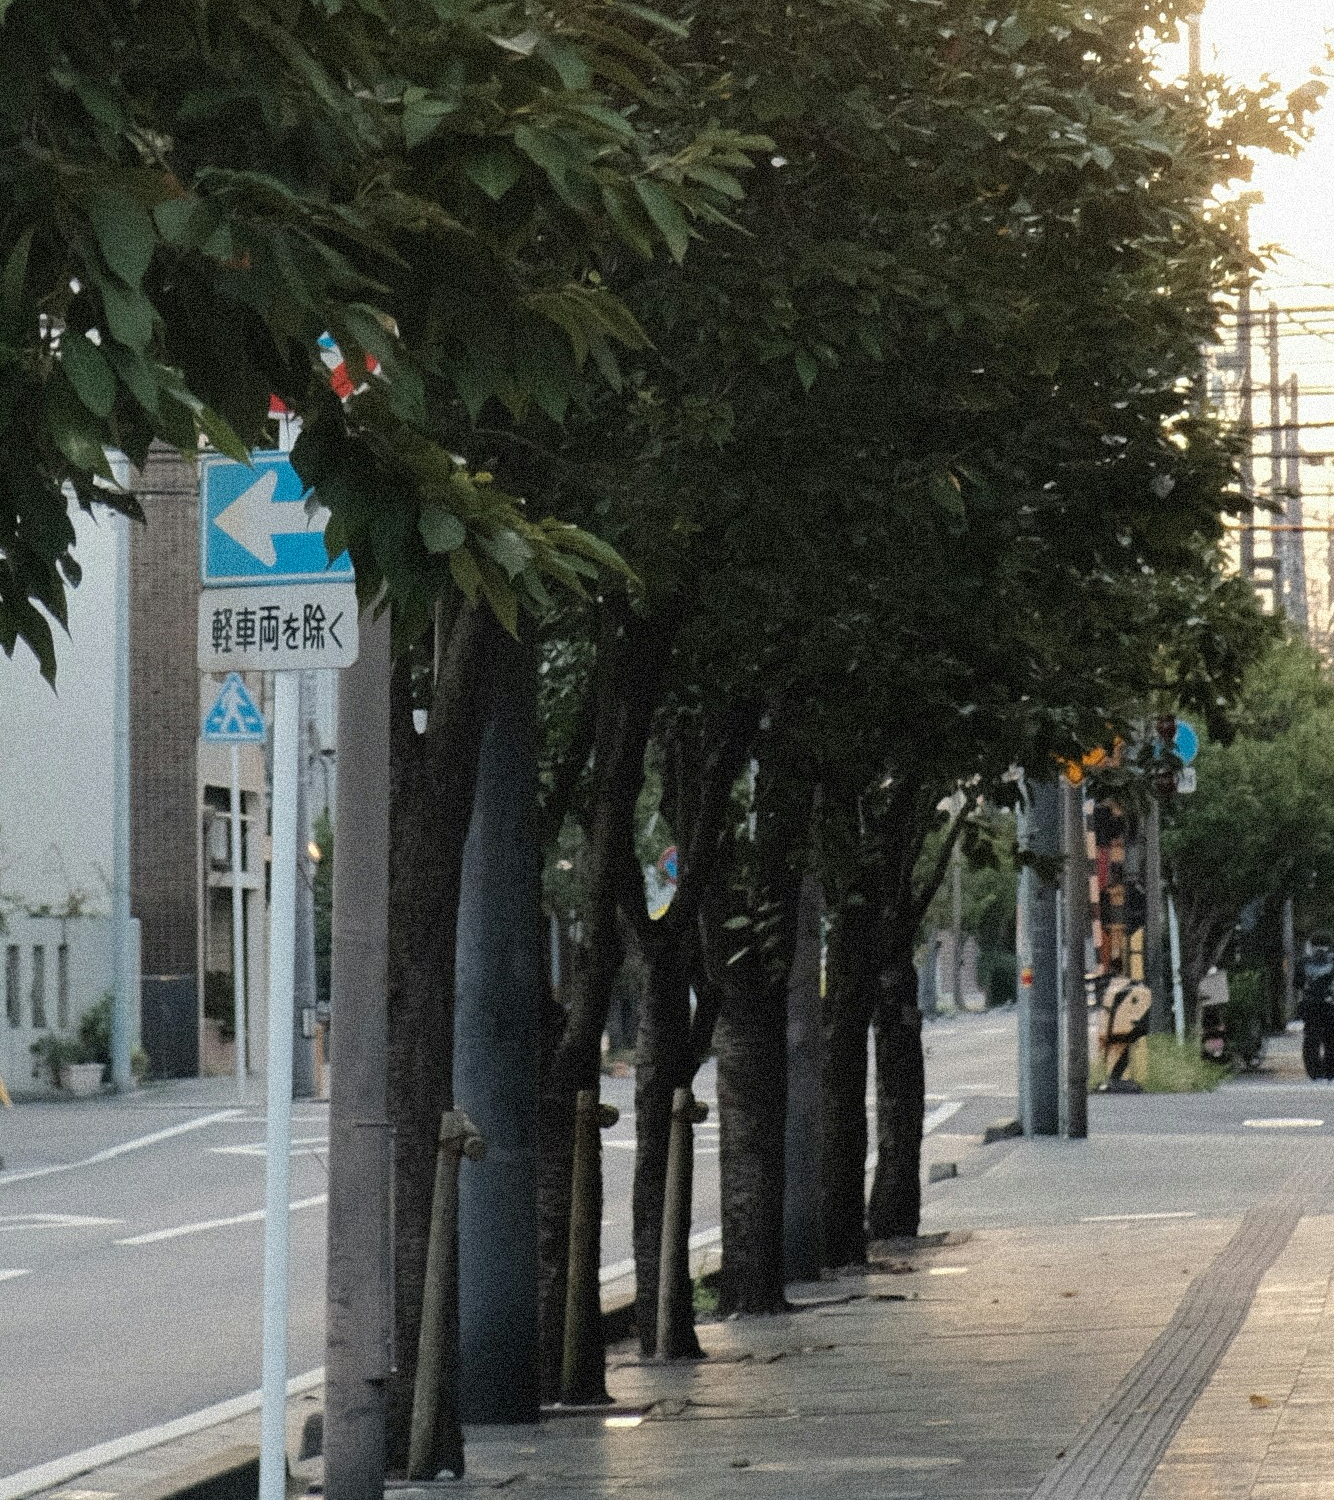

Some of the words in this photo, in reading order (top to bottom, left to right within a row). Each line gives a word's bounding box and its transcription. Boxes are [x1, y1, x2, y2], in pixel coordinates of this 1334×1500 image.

[212, 604, 343, 654] 軽車両を除く
